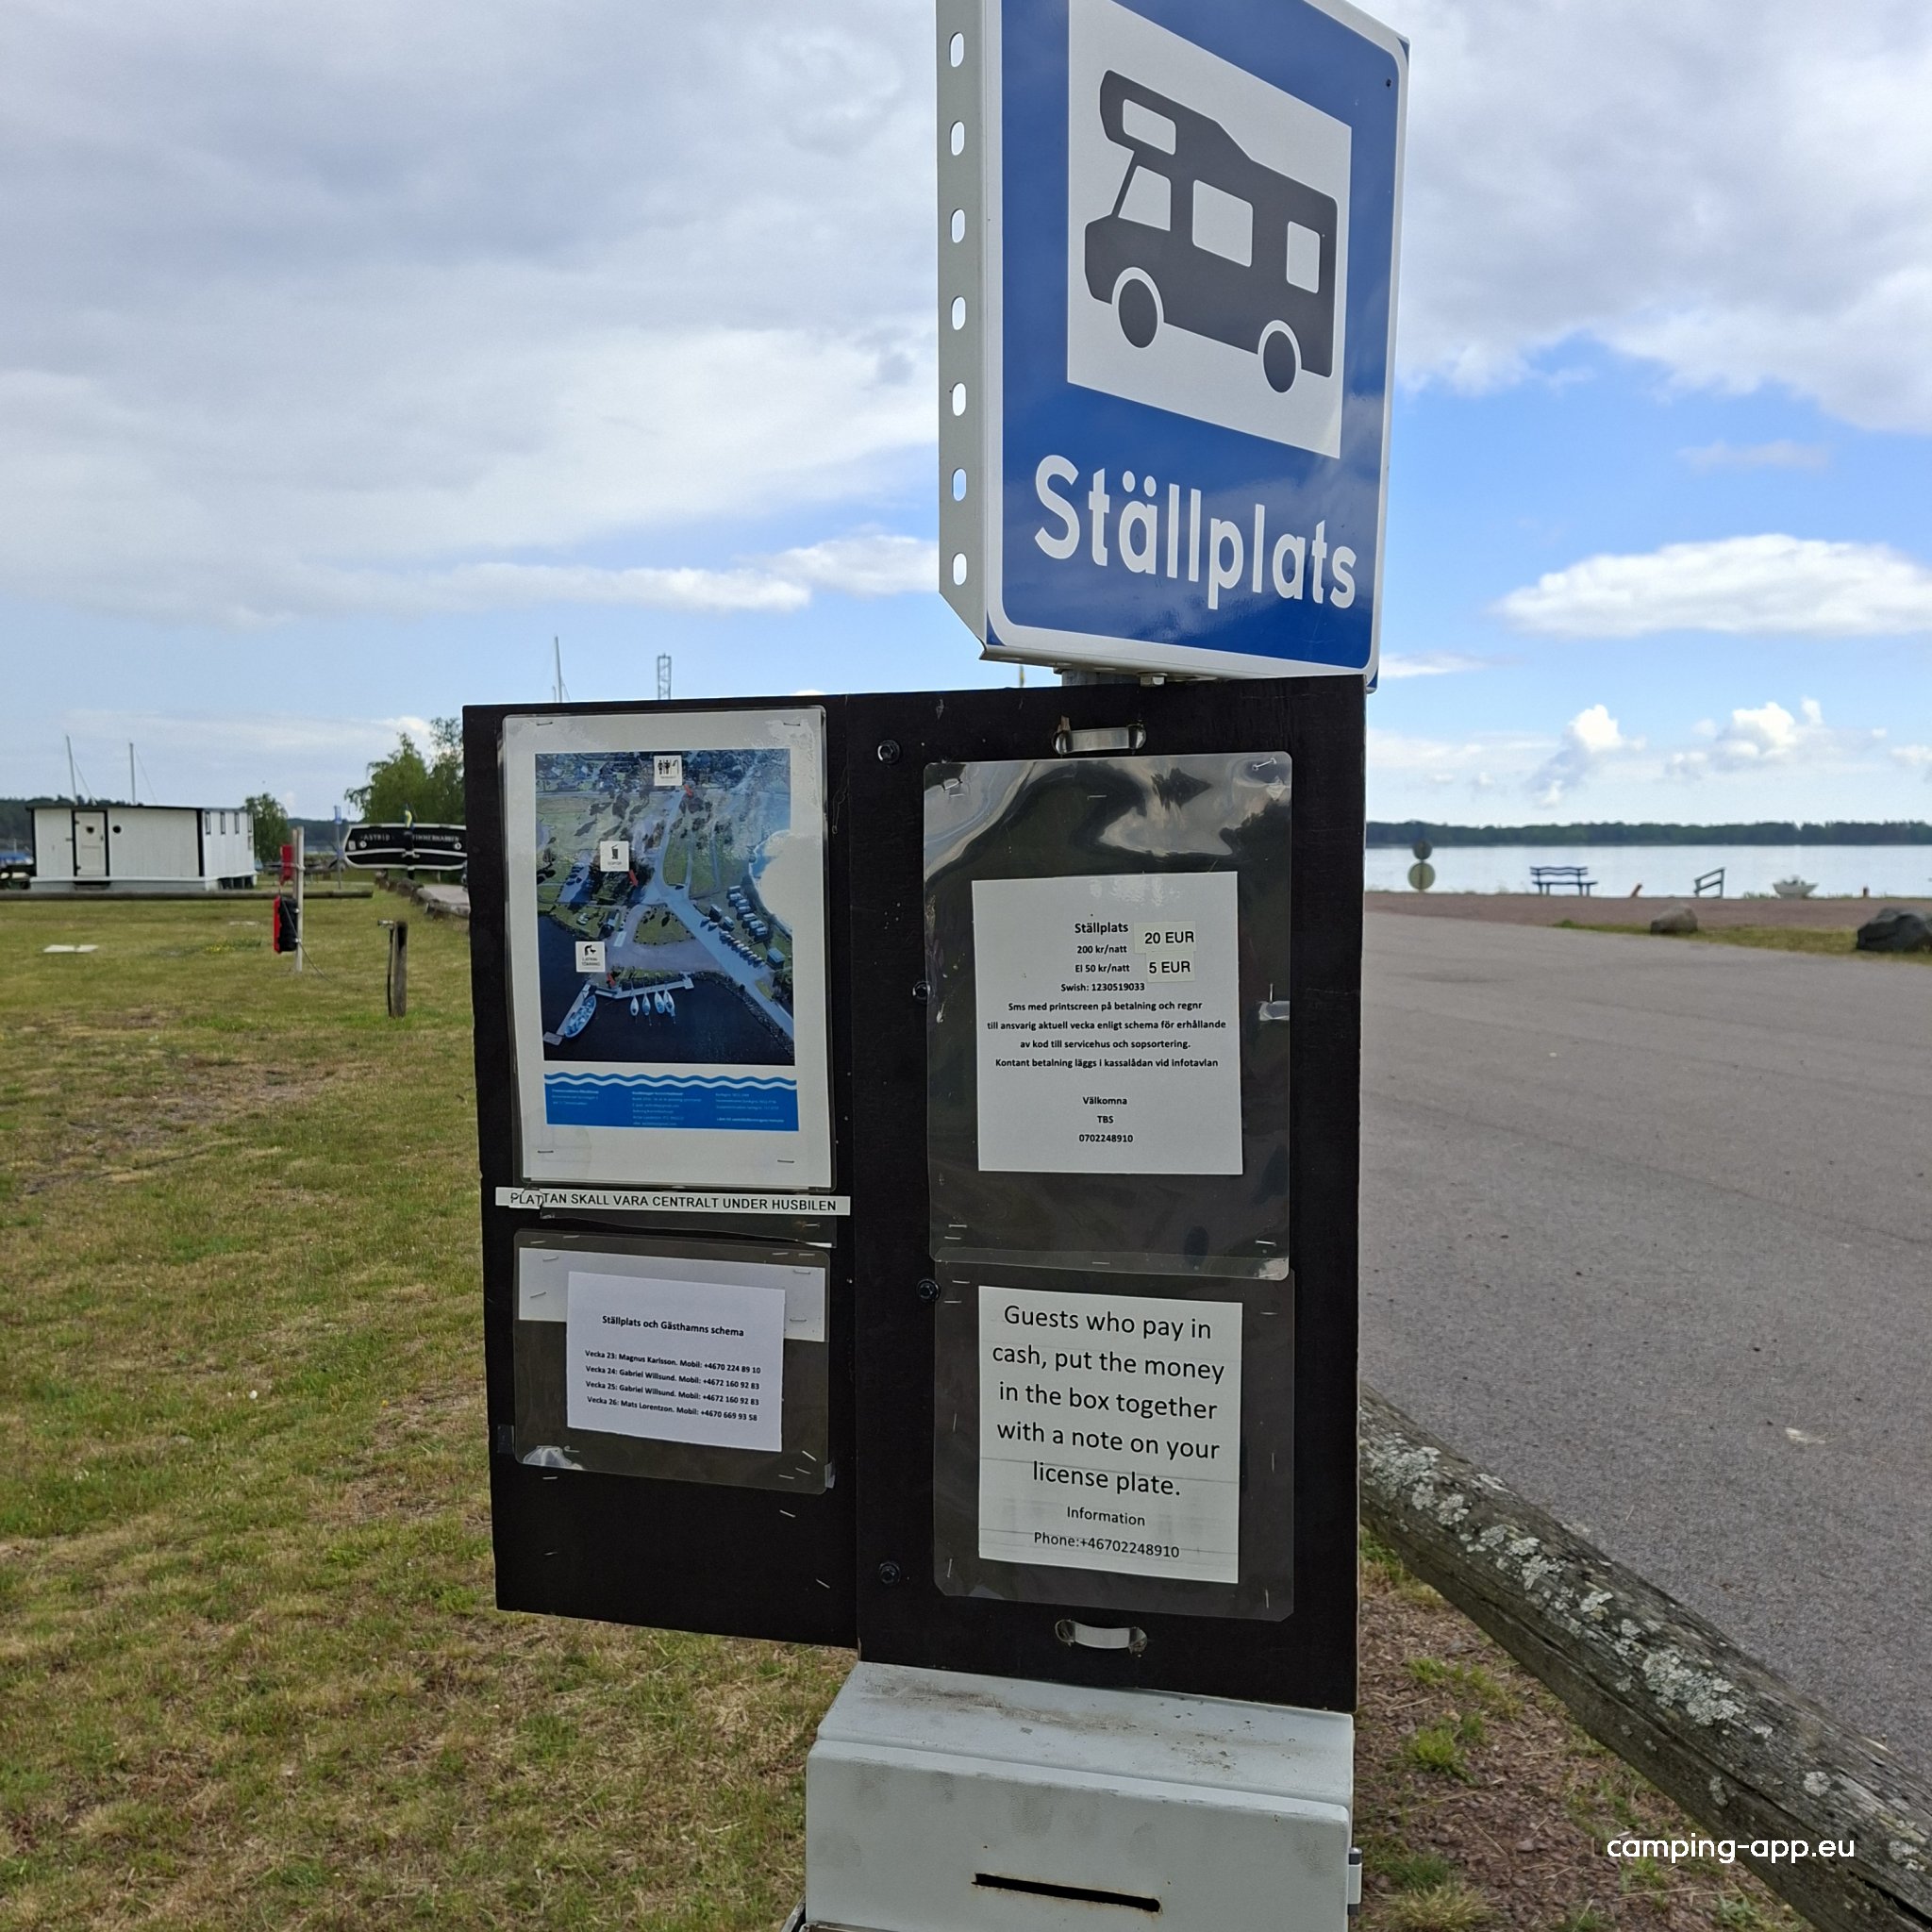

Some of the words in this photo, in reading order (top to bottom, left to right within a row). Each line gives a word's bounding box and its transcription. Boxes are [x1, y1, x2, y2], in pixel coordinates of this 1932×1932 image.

[1035, 455, 1357, 609] Ställplats
[1074, 922, 1129, 936] Ställplats
[1145, 932, 1161, 945] 20
[1166, 931, 1194, 944] EUR
[1077, 946, 1093, 955] 200
[1096, 944, 1127, 955] kr/natt
[1075, 965, 1083, 974] El
[1098, 964, 1130, 974] kr/natt
[1150, 962, 1158, 974] 5
[1161, 961, 1191, 974] EUR
[1061, 984, 1090, 992] Swish:
[1092, 983, 1145, 991] 1230519033
[1008, 1003, 1026, 1011] Sms
[1028, 1003, 1047, 1011] med
[1050, 1003, 1099, 1012] printscreen
[1102, 1002, 1112, 1012] på
[1115, 1002, 1157, 1012] betalning
[1159, 1002, 1175, 1010] och
[1178, 1003, 1203, 1011] regnr
[988, 1022, 999, 1030] till
[1001, 1022, 1037, 1032] ansvarig
[1039, 1022, 1068, 1030] aktuell
[1097, 1022, 1123, 1031] enligt
[1124, 1021, 1159, 1029] schema
[1161, 1021, 1175, 1029] för
[1177, 1020, 1226, 1029] erhållande
[1131, 1041, 1191, 1050] sopsortering.
[1032, 1058, 1074, 1069] betalning
[1075, 1059, 1097, 1069] läggs
[1099, 1058, 1104, 1068] i
[1105, 1058, 1154, 1067] kassalådan
[1156, 1058, 1170, 1067] vid
[1172, 1058, 1219, 1067] infotavlan
[1083, 1097, 1127, 1106] Välkomna
[1097, 1116, 1114, 1124] TBS
[1079, 1135, 1134, 1143] 0702248910
[571, 1193, 609, 1207] SKALL
[613, 1194, 650, 1208] VARA
[652, 1195, 720, 1209] CENTRALT
[723, 1197, 769, 1210] UNDER
[772, 1198, 837, 1211] HUSBILEN
[603, 1316, 641, 1327] Ställplats
[643, 1321, 658, 1329] och
[661, 1322, 709, 1334] Gästhamns
[711, 1326, 744, 1337] schema
[1005, 1306, 1078, 1328] Guests
[1087, 1311, 1134, 1333] who
[1144, 1320, 1183, 1341] pay
[1191, 1319, 1210, 1339] in
[619, 1354, 646, 1363] Magnus
[647, 1357, 678, 1366] Karlsson.
[993, 1345, 1046, 1369] cash,
[1056, 1351, 1091, 1372] put
[1099, 1352, 1136, 1373] the
[1145, 1360, 1224, 1384] money
[620, 1370, 644, 1378] Gabriel
[645, 1373, 677, 1382] Willsund.
[586, 1381, 607, 1390] Vecka
[620, 1385, 643, 1393] Gabriel
[645, 1388, 677, 1397] Willsund.
[678, 1391, 701, 1400] Mobil:
[703, 1394, 724, 1403] +4672
[588, 1396, 608, 1405] Vecka
[621, 1400, 638, 1408] Mats
[640, 1403, 675, 1413] Lorentzon.
[1000, 1382, 1017, 1401] in
[1025, 1384, 1061, 1405] the
[1070, 1388, 1108, 1410] box
[1116, 1394, 1217, 1419] together
[997, 1422, 1044, 1441] with
[1053, 1428, 1064, 1444] a
[1073, 1431, 1122, 1450] note
[1131, 1438, 1158, 1454] on
[1167, 1441, 1220, 1460] your
[1033, 1461, 1108, 1489] license
[1116, 1472, 1181, 1496] plate.
[1068, 1507, 1144, 1525] Information
[1033, 1532, 1180, 1558] Phone:+46702248910
